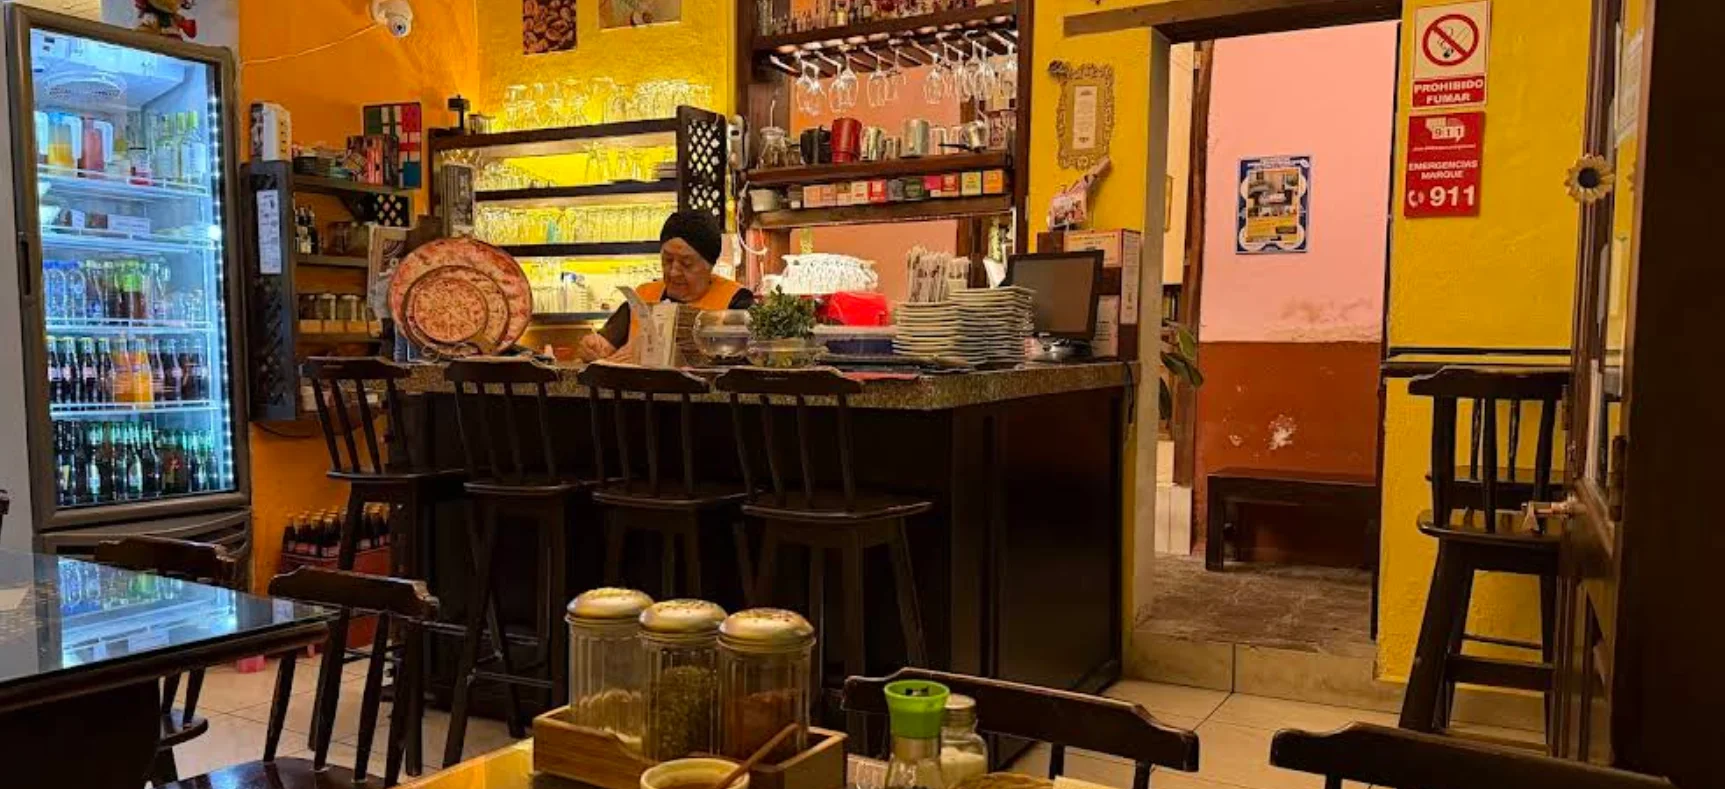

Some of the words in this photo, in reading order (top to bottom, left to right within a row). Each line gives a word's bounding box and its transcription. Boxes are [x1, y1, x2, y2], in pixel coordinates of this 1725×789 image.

[1414, 79, 1484, 94] PROHIBIDO
[1426, 93, 1471, 104] FUMAR
[1408, 160, 1478, 171] EMERGENCIAS
[1421, 171, 1464, 180] MARQUE
[1430, 184, 1475, 206] 911
